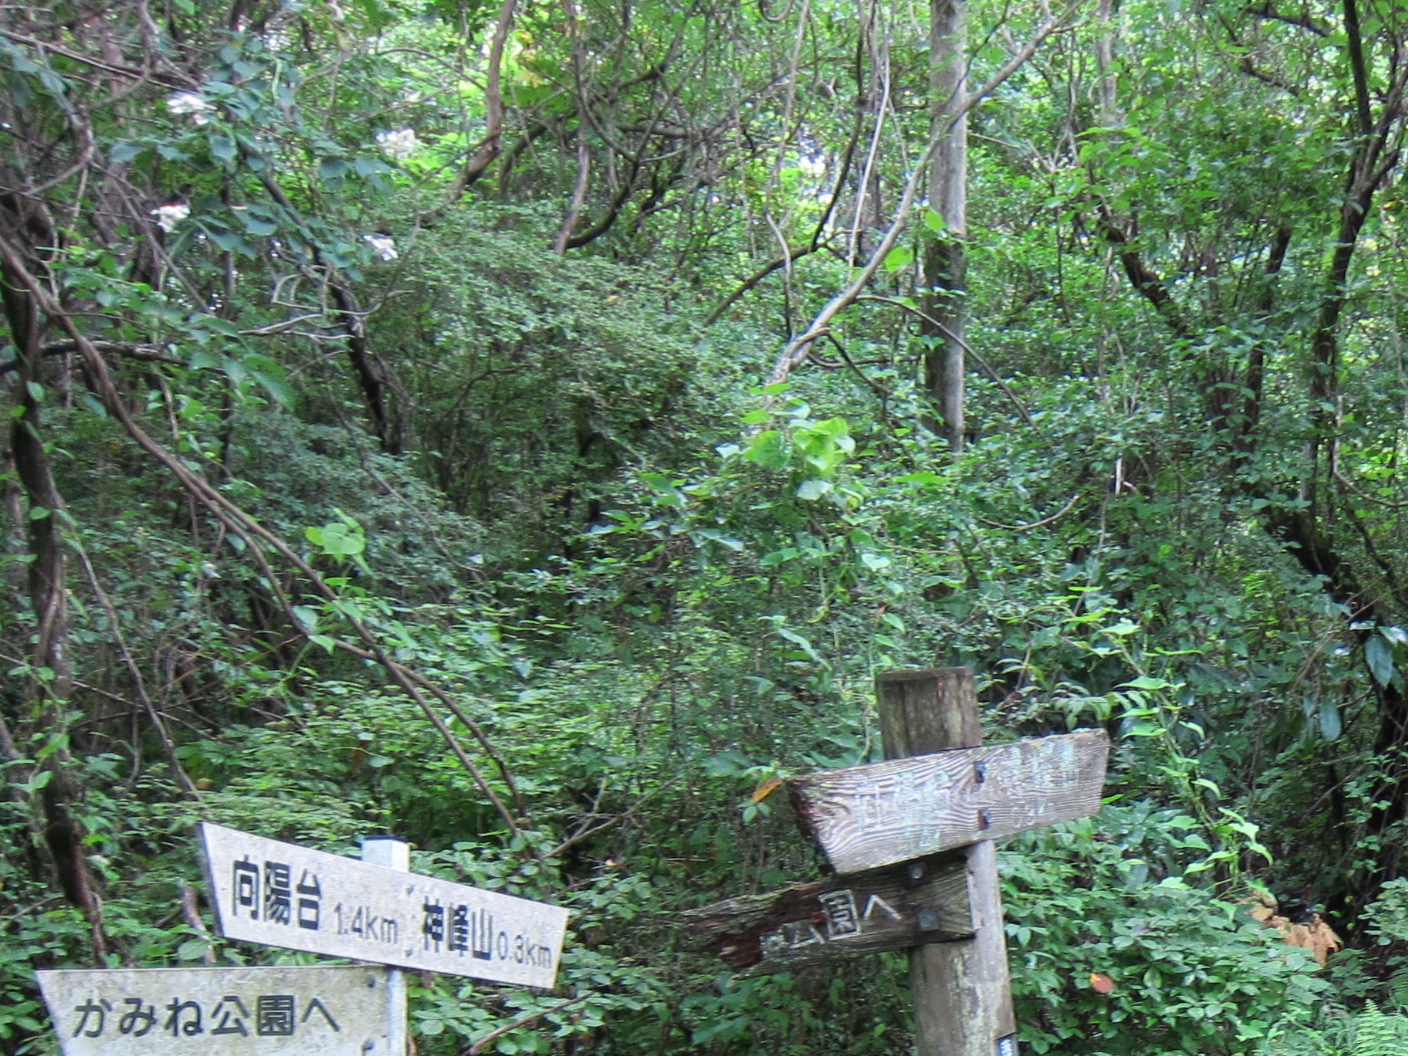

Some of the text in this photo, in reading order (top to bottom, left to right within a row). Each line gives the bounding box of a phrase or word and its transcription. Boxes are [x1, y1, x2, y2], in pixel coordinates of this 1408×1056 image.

[231, 854, 552, 970] 向陽台 1.4km 神峰山 0.3km
[72, 994, 342, 1038] かみね公園へ
